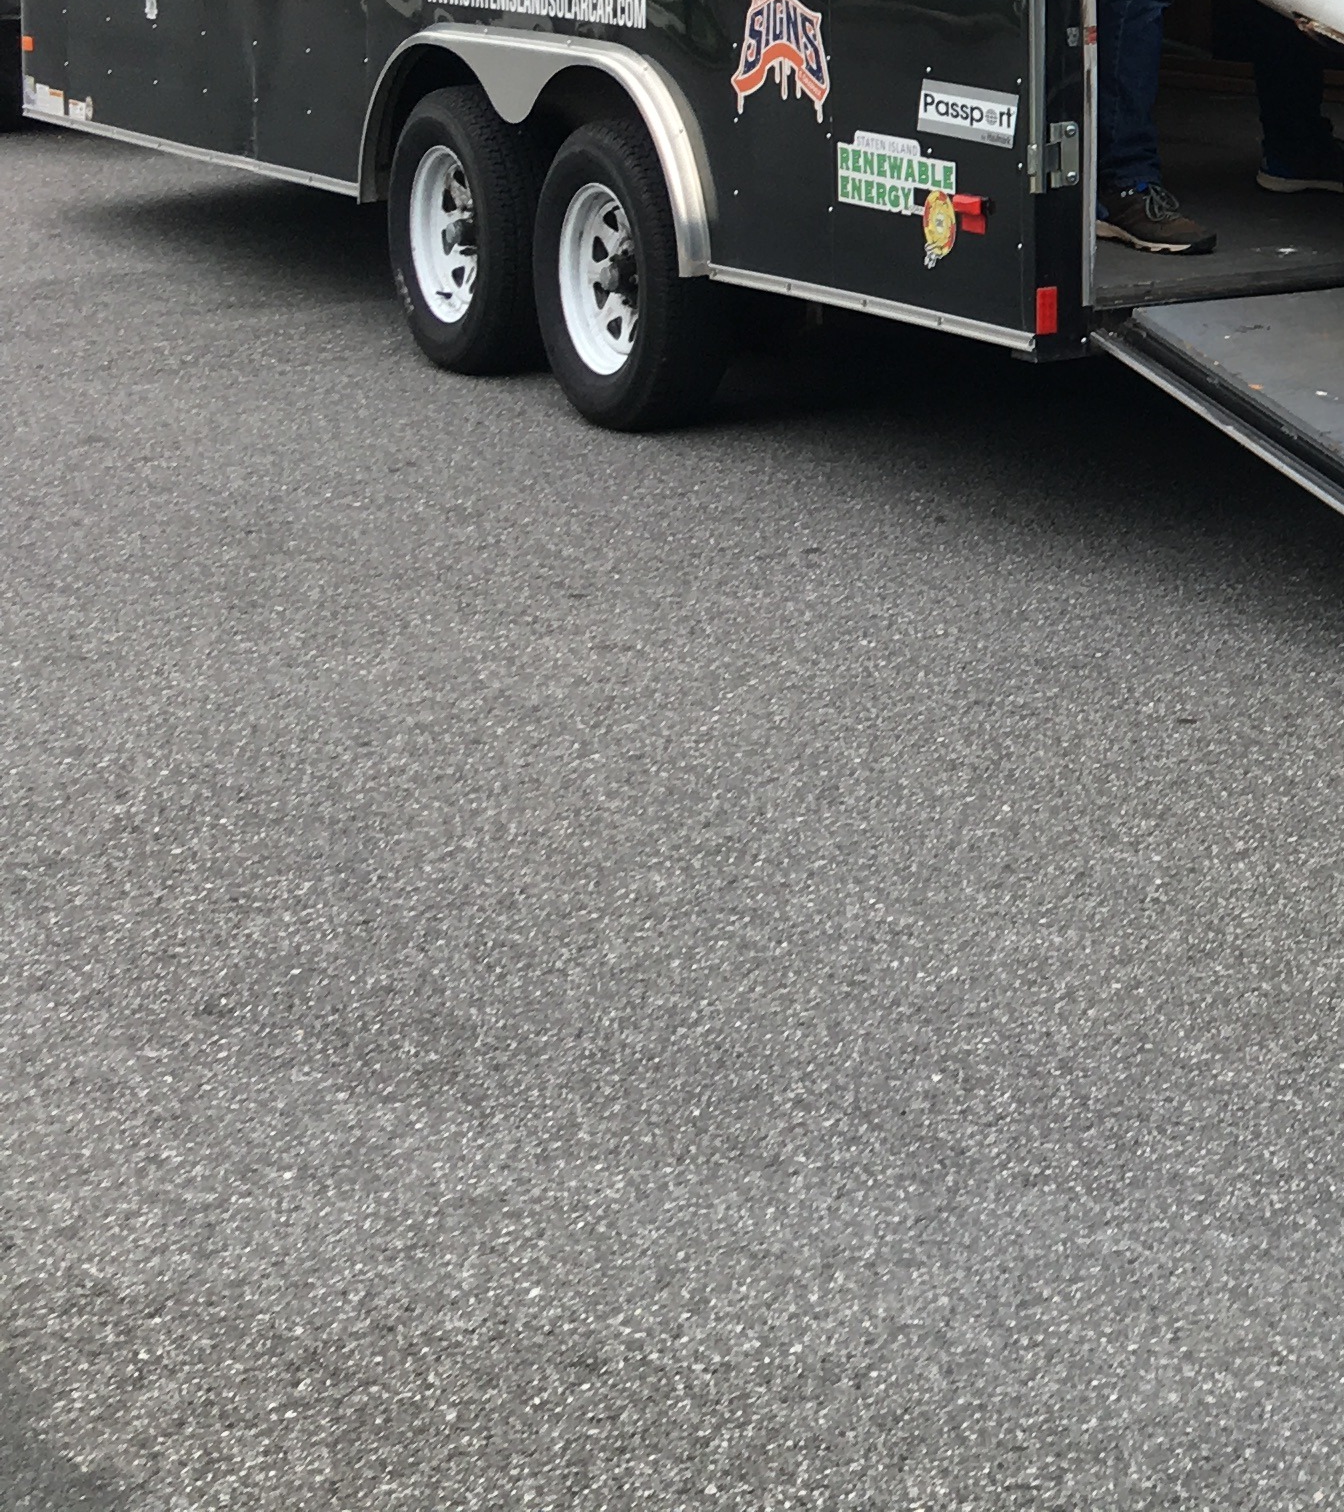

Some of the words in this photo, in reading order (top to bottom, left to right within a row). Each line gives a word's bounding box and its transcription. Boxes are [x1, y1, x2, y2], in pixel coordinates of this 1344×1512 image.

[923, 93, 1013, 128] Passport
[857, 135, 886, 152] STATEN
[888, 143, 918, 156] ISLAND
[839, 147, 954, 190] RENEWABLE
[840, 175, 913, 210] ENERGY
